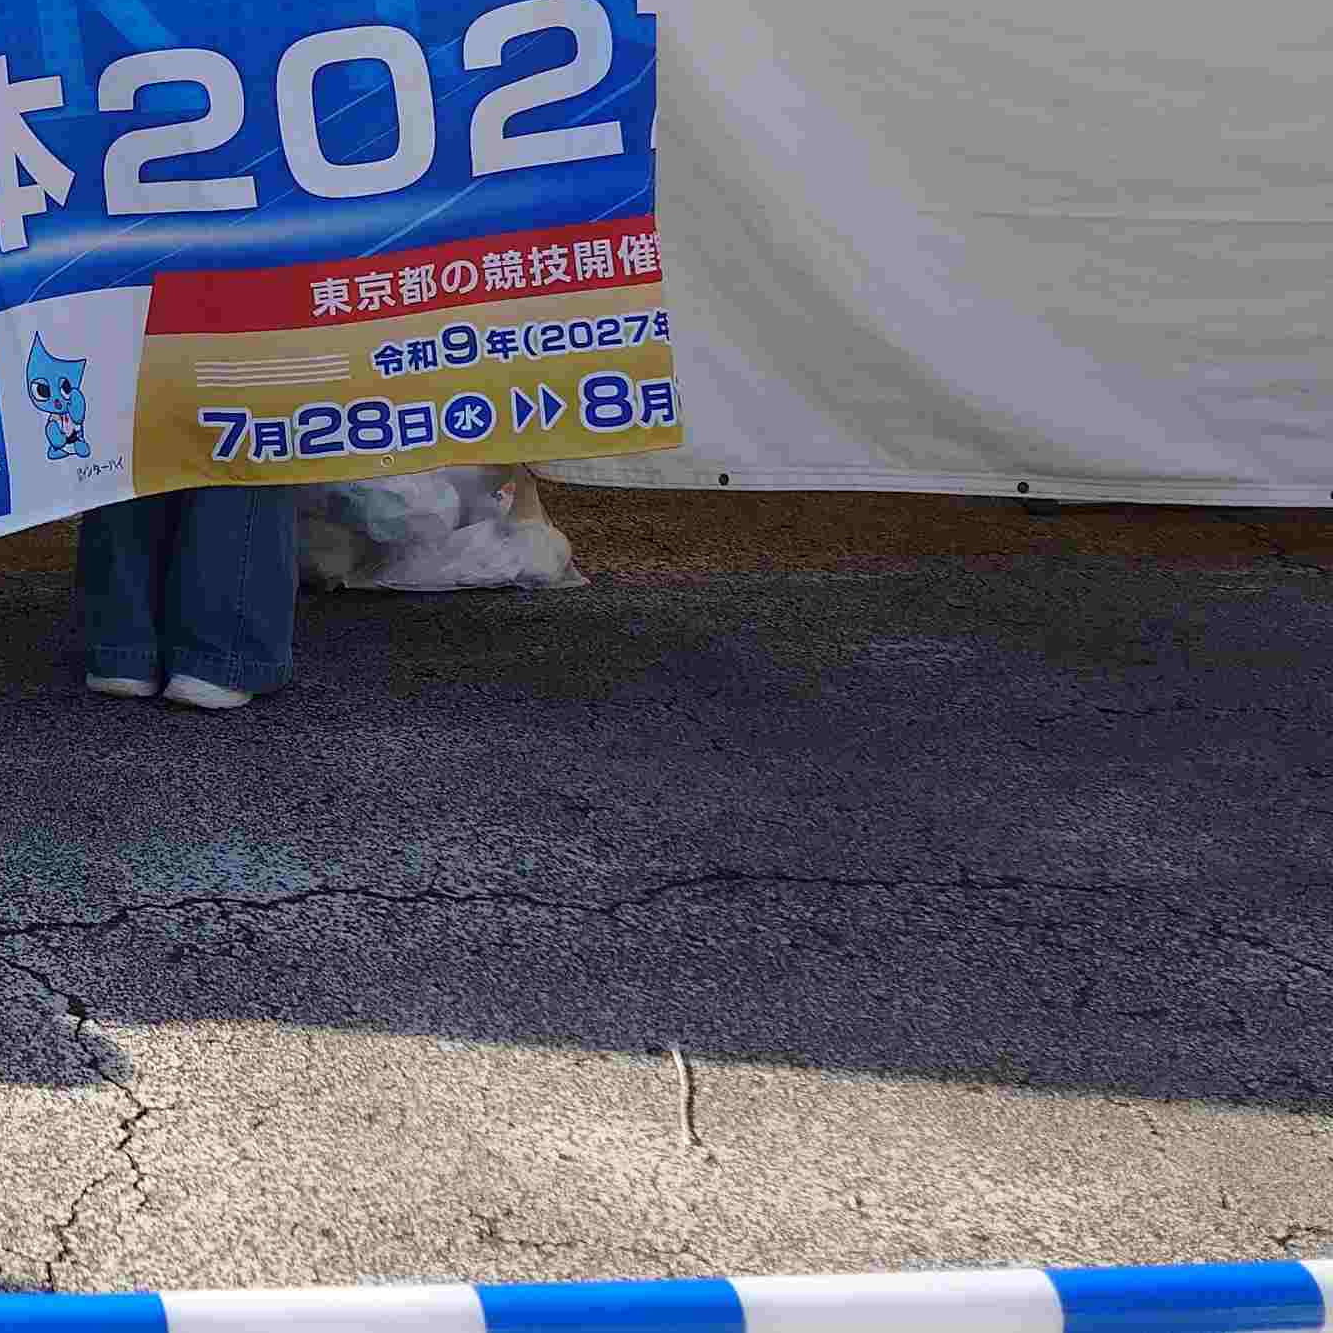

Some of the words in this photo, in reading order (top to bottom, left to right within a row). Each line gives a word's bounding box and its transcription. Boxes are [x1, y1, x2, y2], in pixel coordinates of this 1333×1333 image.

[310, 233, 661, 317] 東京都の競技開催
